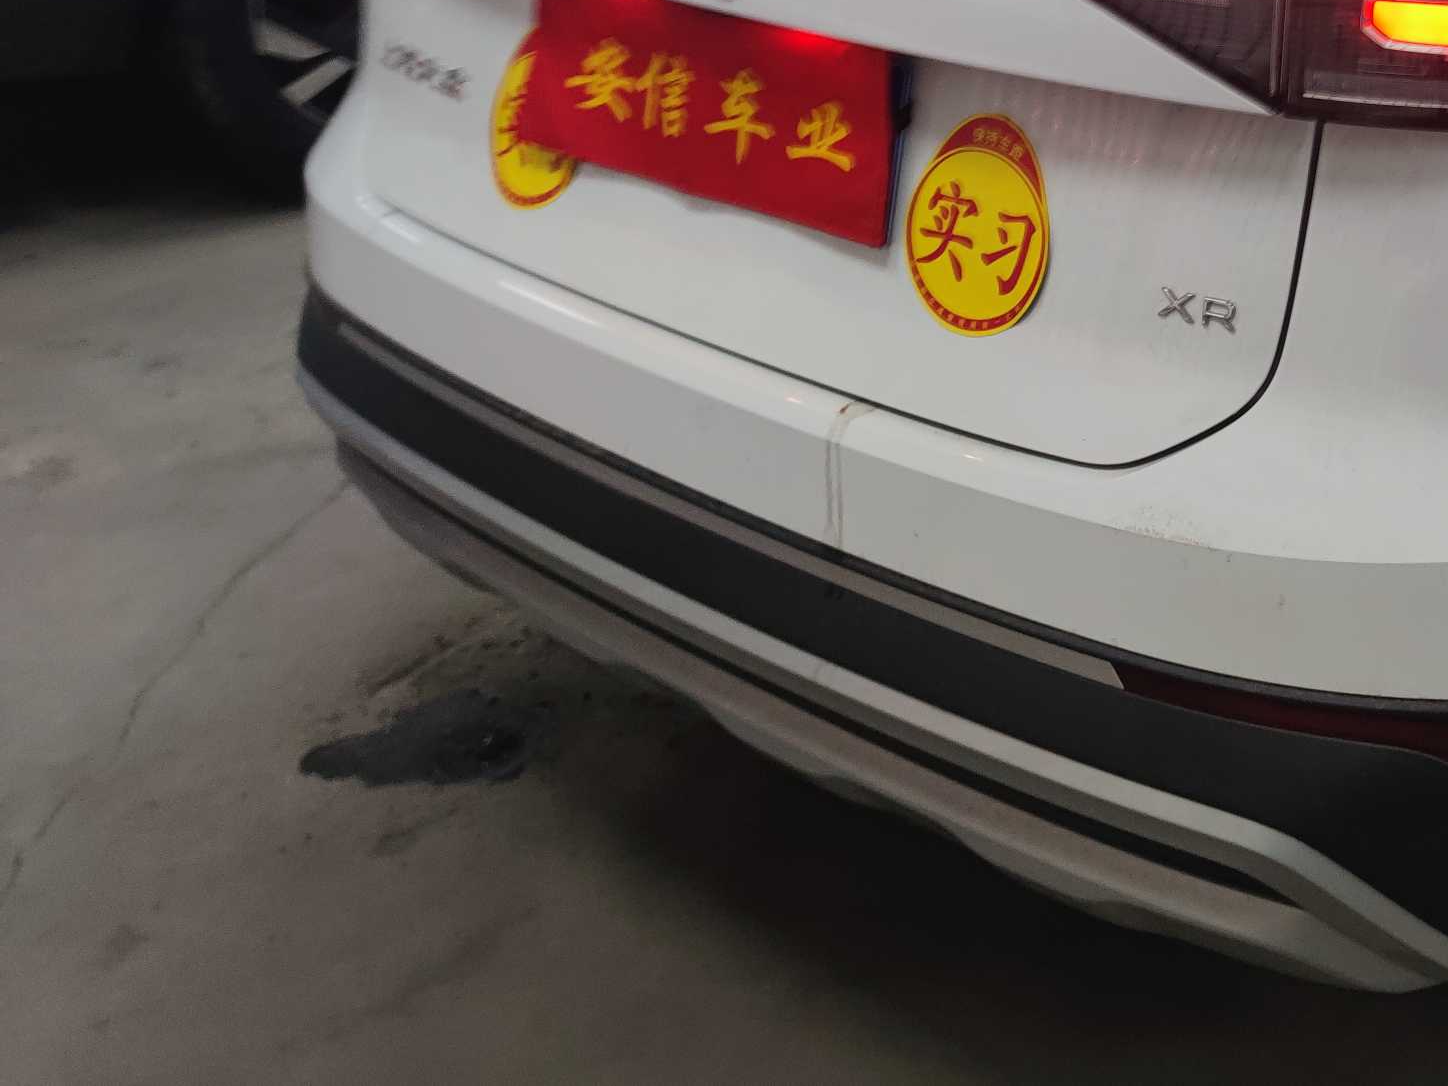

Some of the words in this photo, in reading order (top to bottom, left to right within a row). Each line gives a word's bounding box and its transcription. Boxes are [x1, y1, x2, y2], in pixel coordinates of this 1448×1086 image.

[563, 37, 857, 172] 安信车业
[915, 181, 1037, 296] 实习
[1157, 286, 1237, 334] XR
